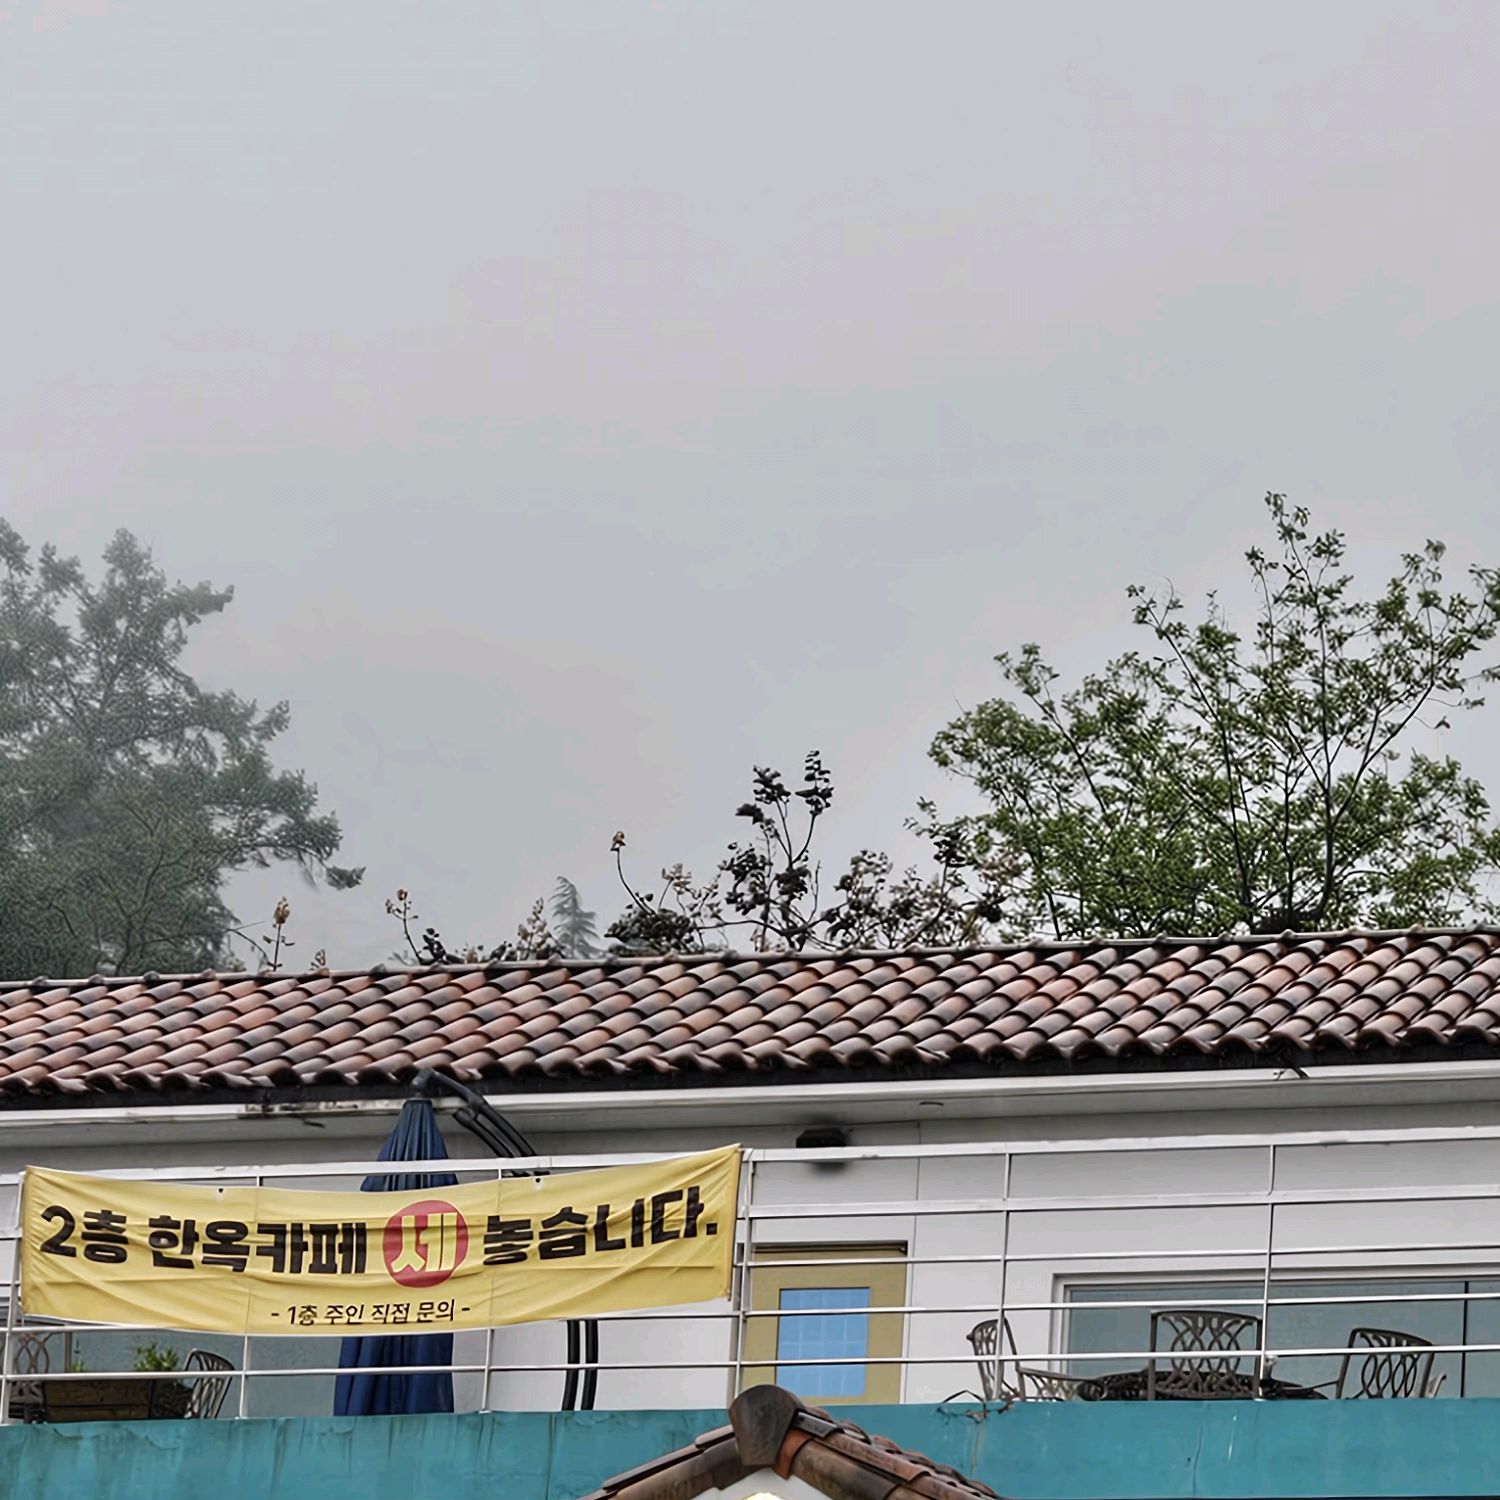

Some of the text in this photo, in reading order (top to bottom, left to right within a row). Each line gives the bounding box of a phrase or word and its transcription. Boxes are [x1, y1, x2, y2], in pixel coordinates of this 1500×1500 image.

[40, 1186, 718, 1275] 2층 한옥카페 세 놓습니다.
[287, 1304, 317, 1326] 1층
[324, 1304, 364, 1326] 주인
[372, 1303, 411, 1325] 직접
[417, 1299, 455, 1323] 문의
